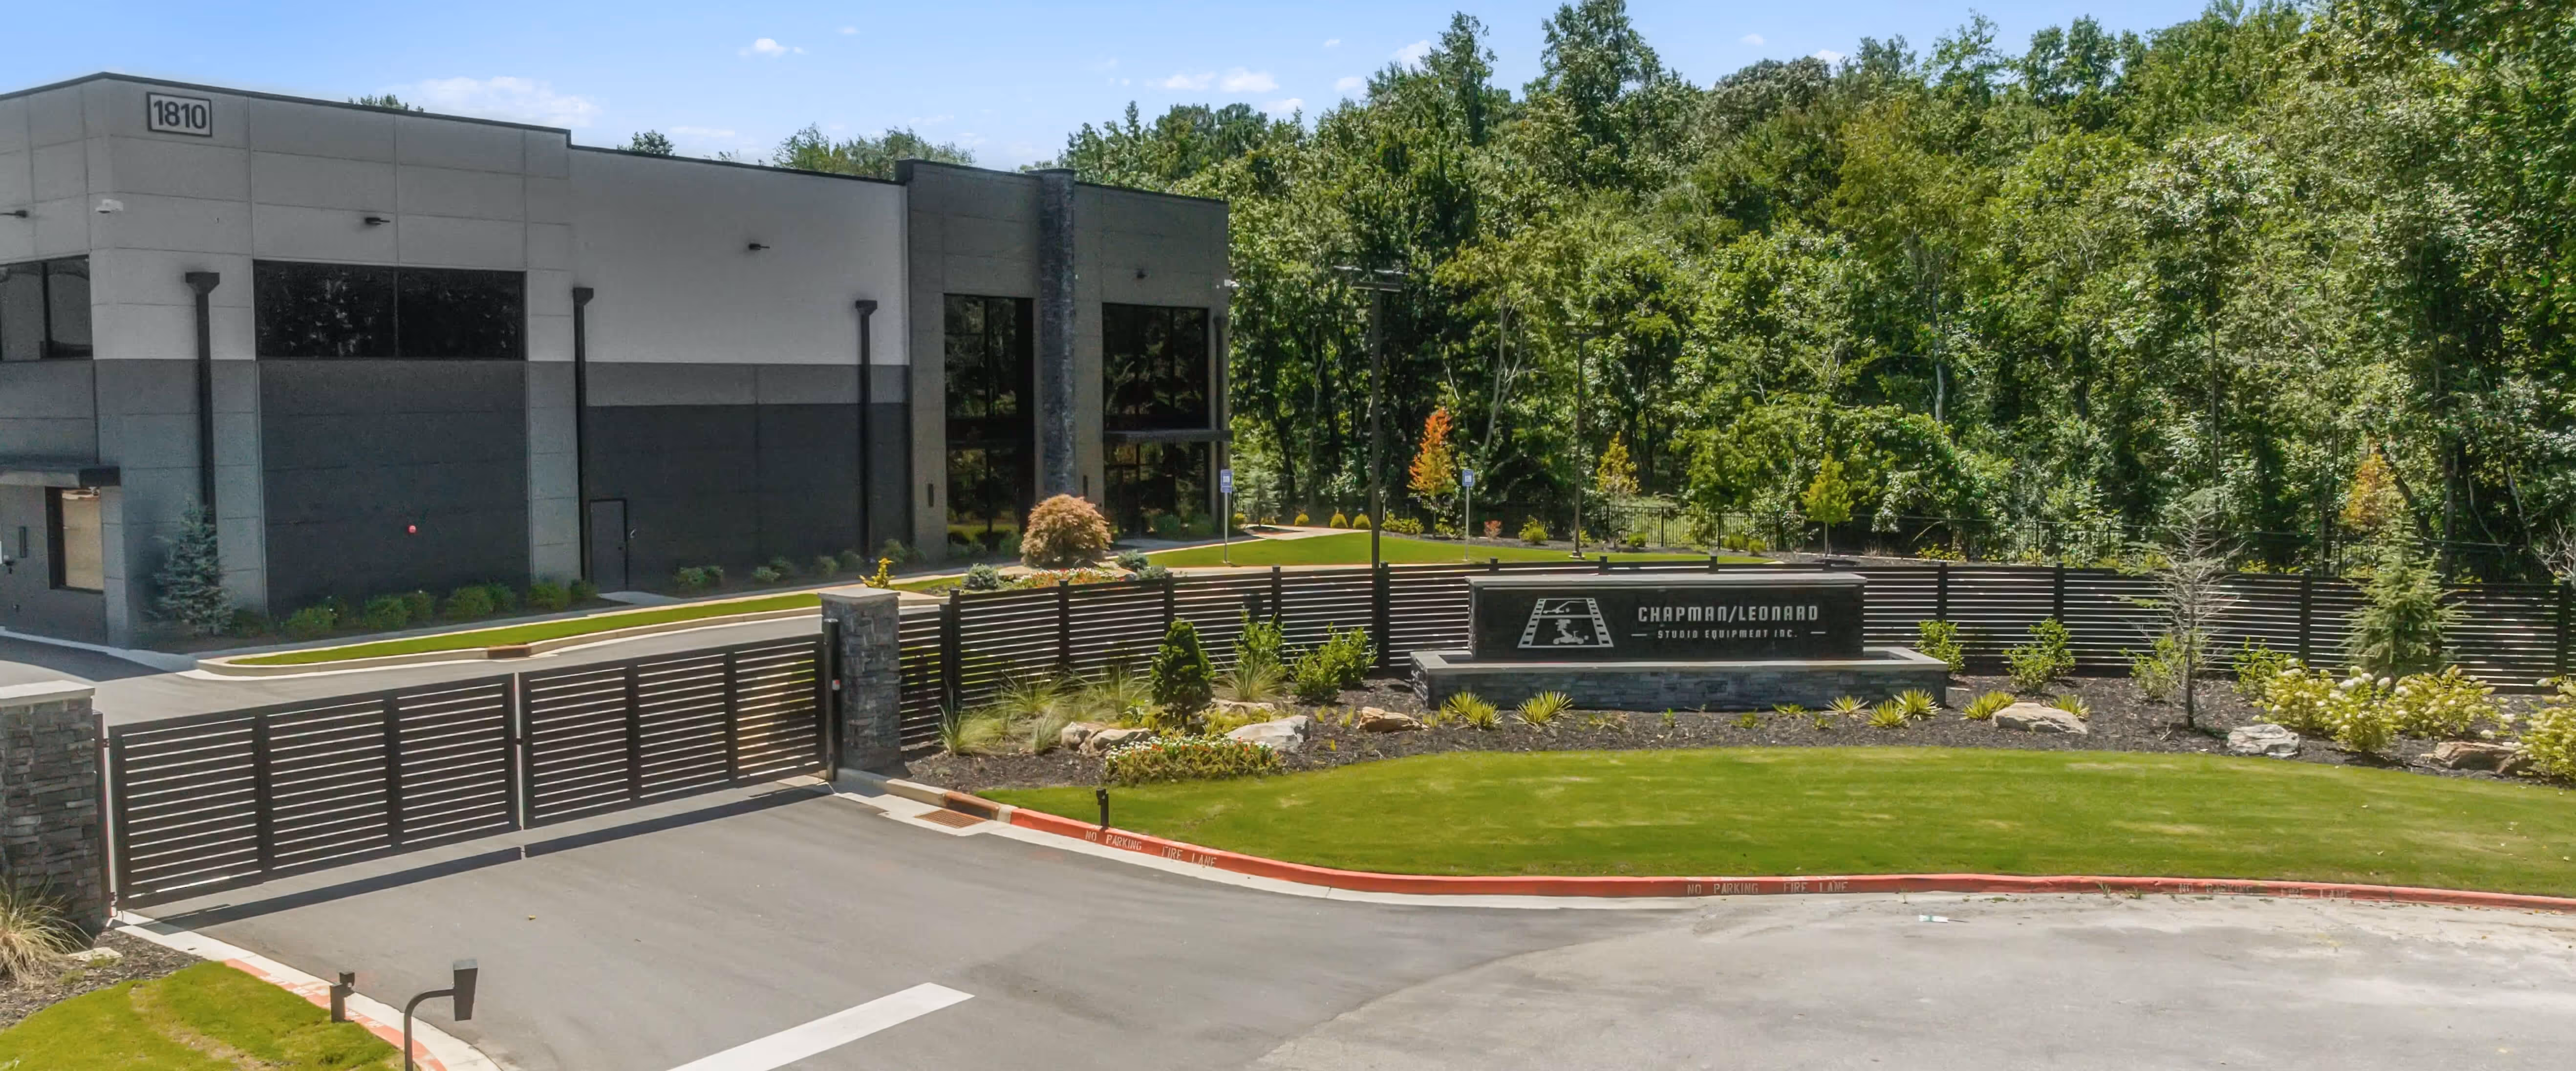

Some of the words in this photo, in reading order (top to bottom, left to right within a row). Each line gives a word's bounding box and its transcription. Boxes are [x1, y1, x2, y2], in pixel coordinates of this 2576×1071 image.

[154, 100, 206, 129] 1810
[1638, 605, 1818, 623] CHAPMAN/LEONARD
[1658, 630, 1698, 639] STUDIO
[1705, 629, 1768, 640] EQUIPMENT
[1774, 629, 1798, 638] INC.
[1085, 830, 1097, 841] NO
[1106, 834, 1142, 851] PARKING
[1161, 846, 1183, 860] FIRE
[1191, 853, 1217, 868] LANE
[1687, 884, 1702, 895] NO
[1714, 883, 1759, 895] PARKING
[1784, 881, 1808, 893] FIRE
[1819, 881, 1848, 893] LANE
